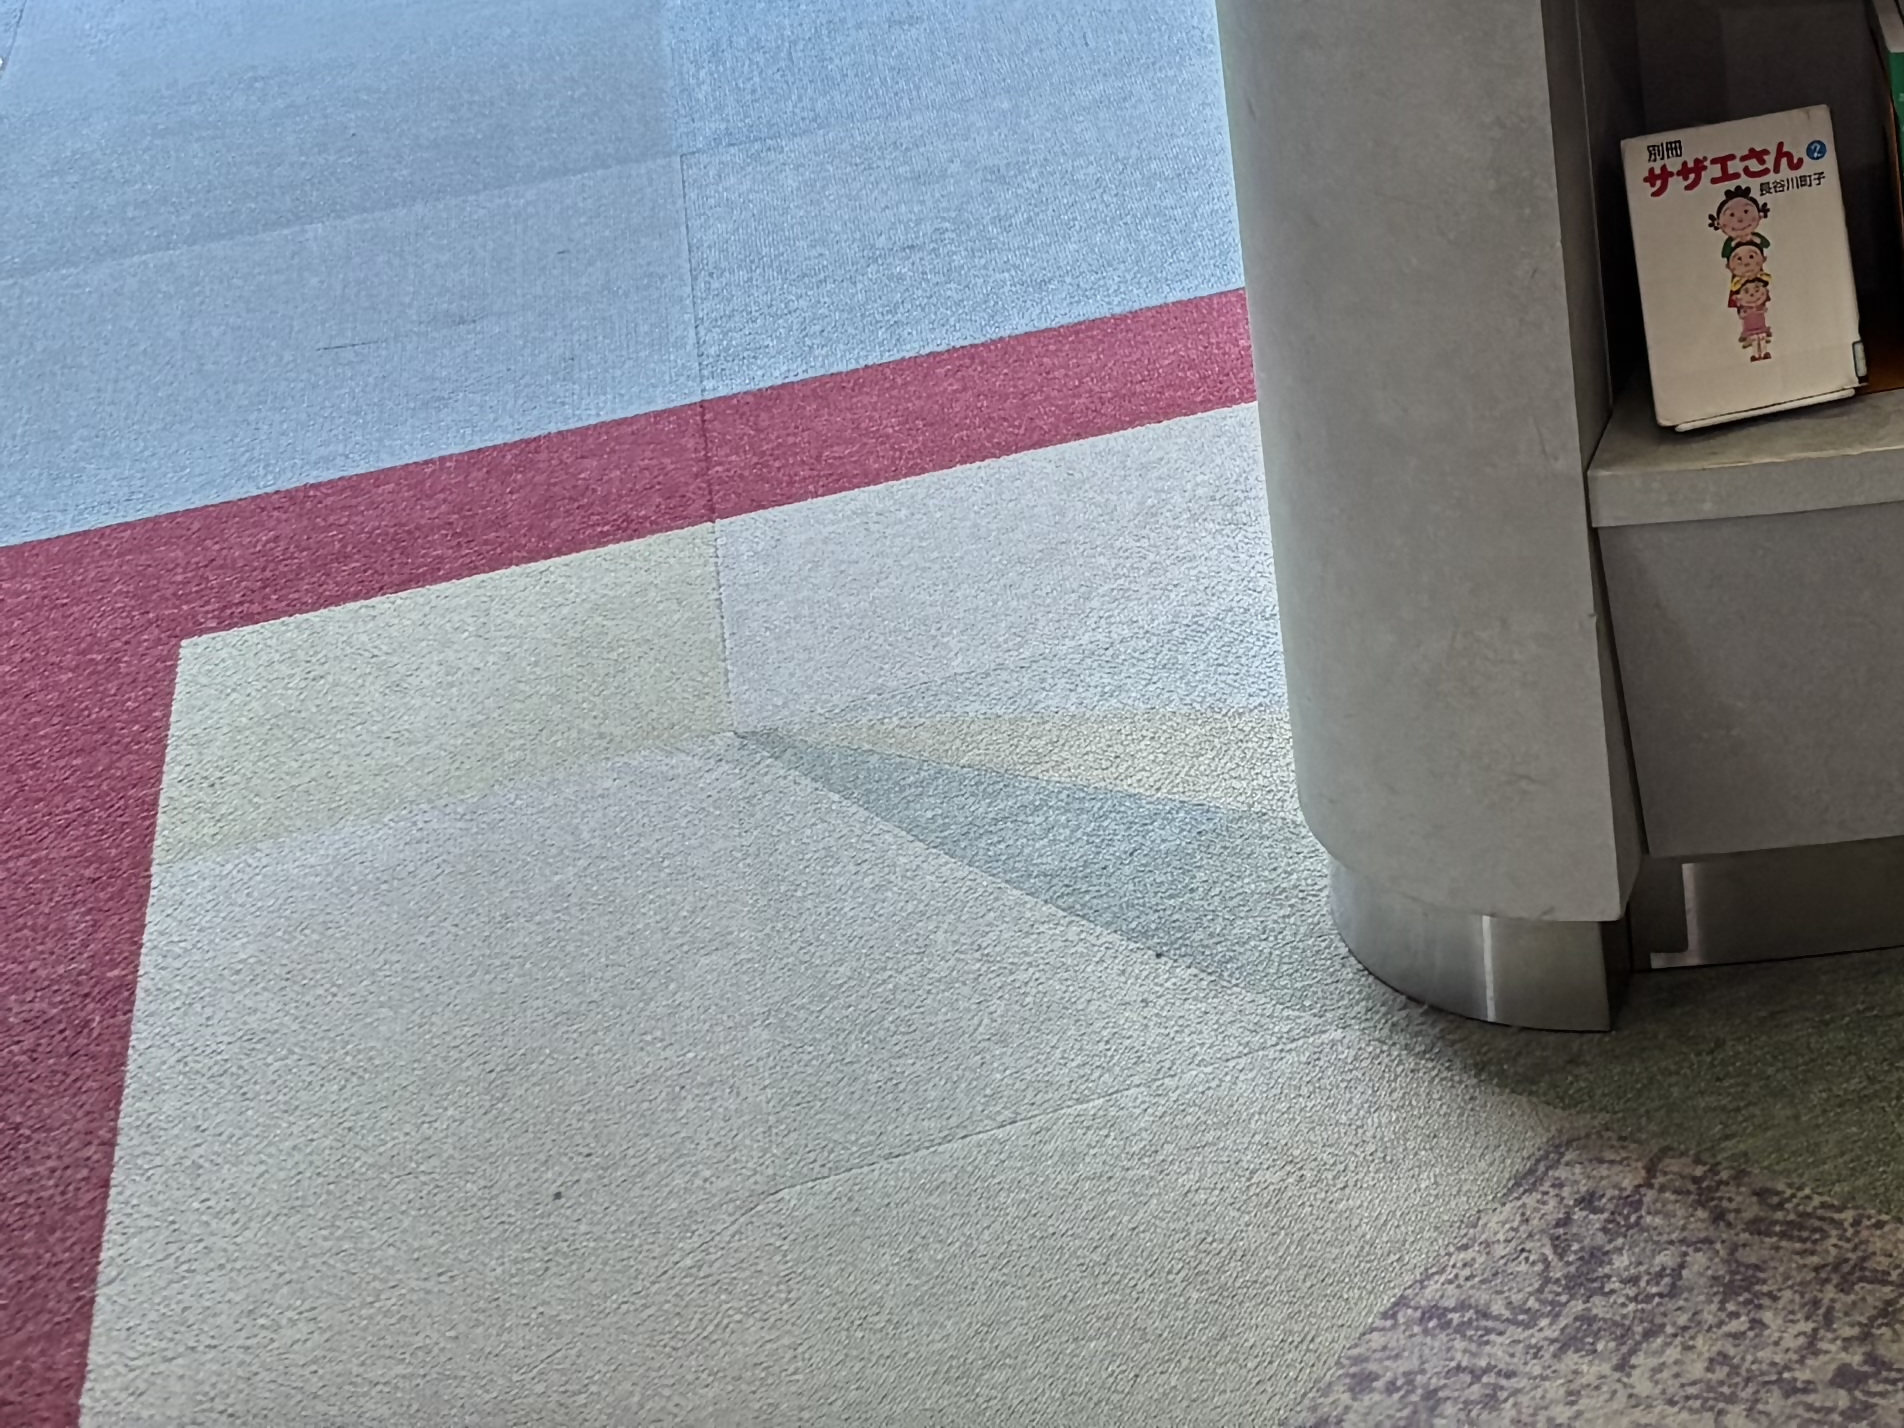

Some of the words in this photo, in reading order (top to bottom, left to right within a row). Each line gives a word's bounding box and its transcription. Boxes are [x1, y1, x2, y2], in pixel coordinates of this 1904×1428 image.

[1646, 139, 1683, 162] 別冊
[1643, 141, 1804, 197] サザエさん
[1759, 171, 1826, 196] 長谷川町子
